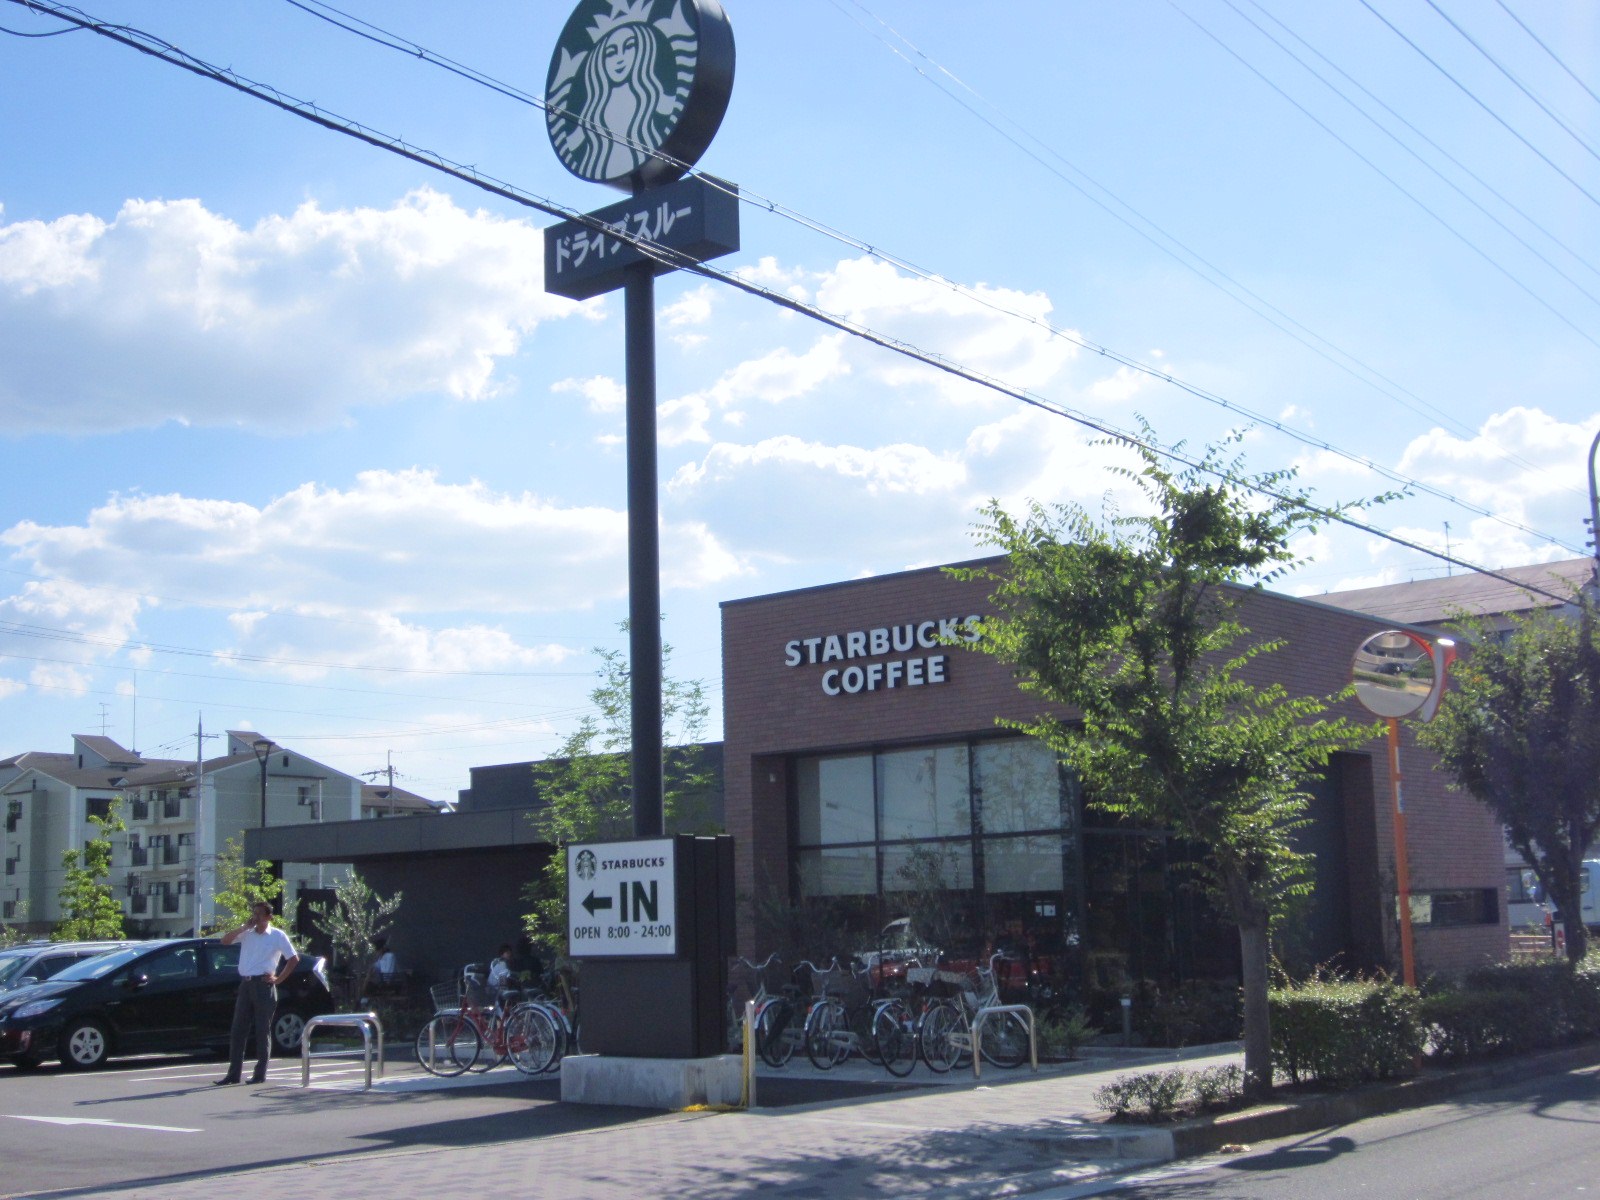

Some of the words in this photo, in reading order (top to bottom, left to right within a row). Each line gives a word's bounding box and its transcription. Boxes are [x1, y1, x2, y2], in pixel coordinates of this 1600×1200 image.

[556, 202, 692, 273] ドライブスルー
[785, 615, 982, 666] STARBUCKS
[821, 655, 945, 696] COFFEE
[601, 857, 665, 870] STARBUCKS
[619, 880, 658, 923] IN
[574, 926, 601, 939] OPEN
[607, 926, 630, 939] 8:00
[641, 924, 671, 938] 24:00
